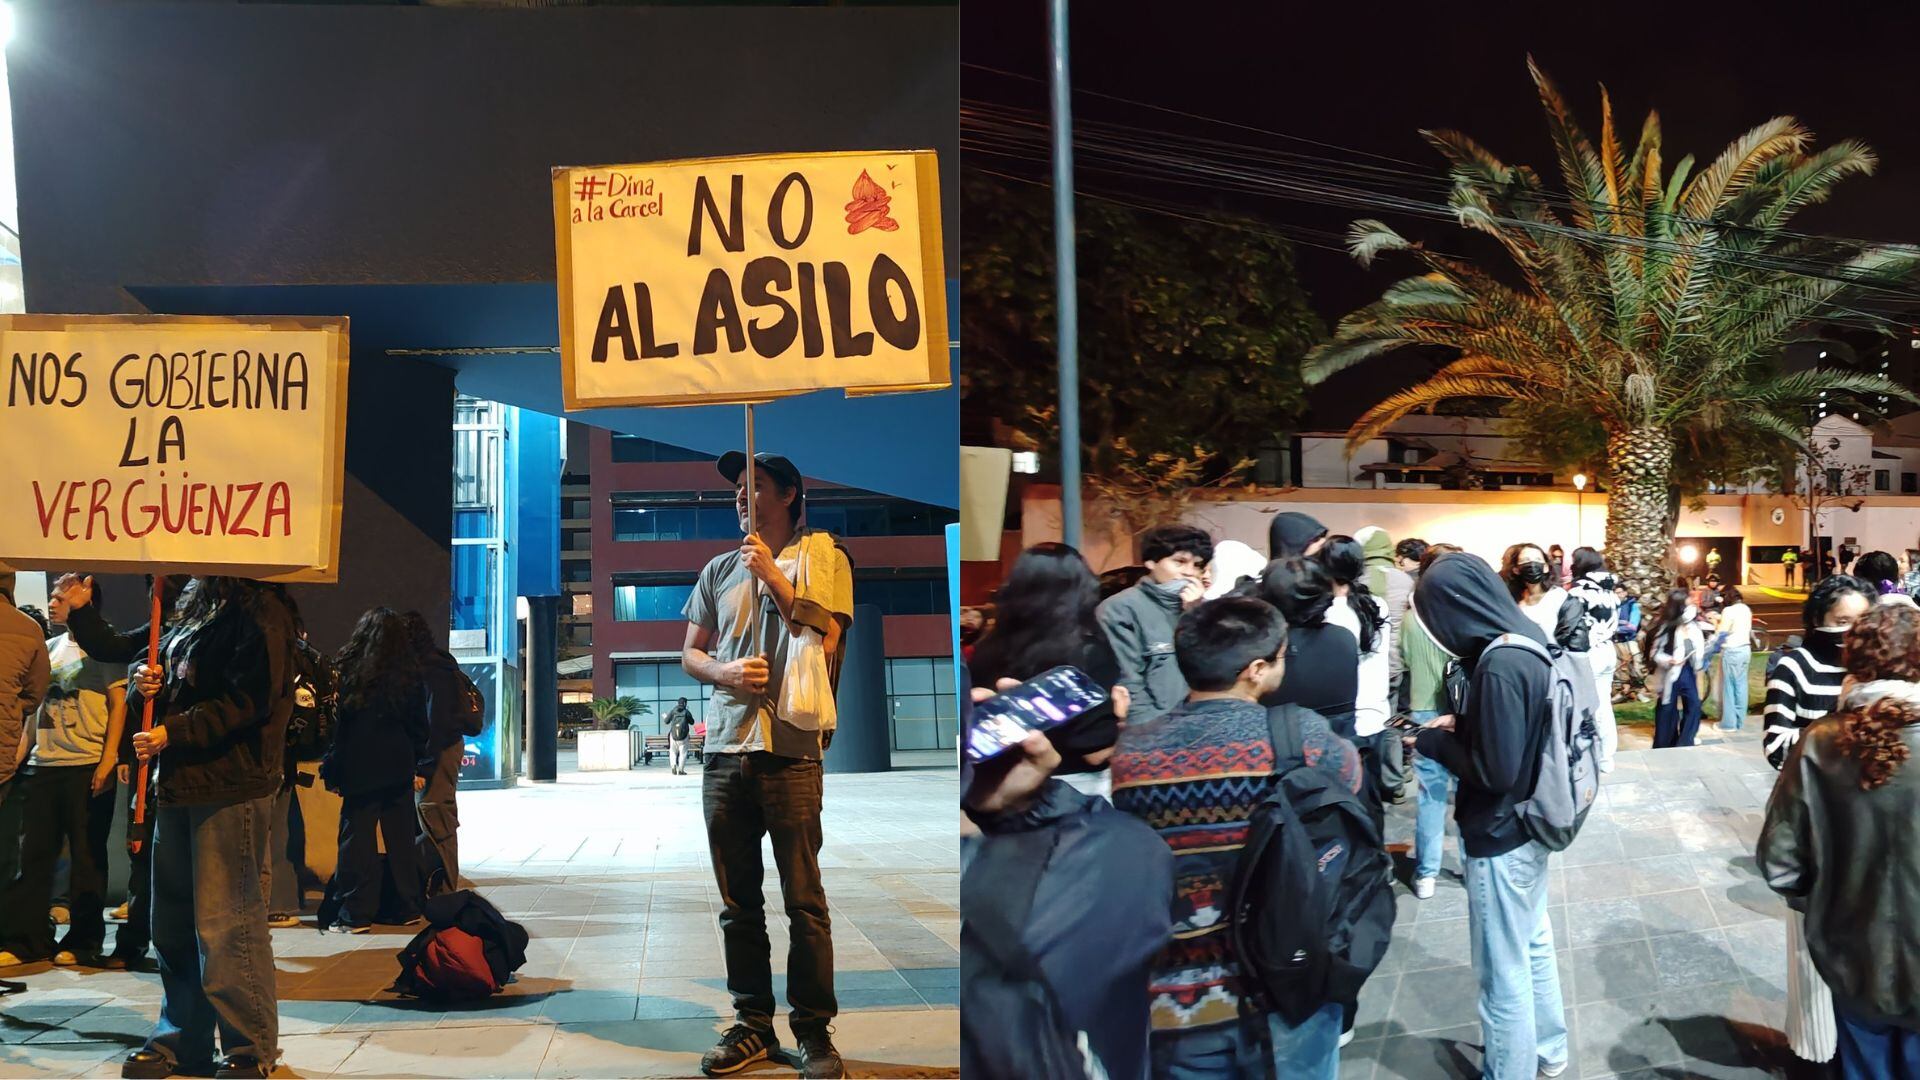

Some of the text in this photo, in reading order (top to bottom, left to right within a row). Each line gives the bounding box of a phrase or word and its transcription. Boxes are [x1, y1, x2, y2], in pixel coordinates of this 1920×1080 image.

[572, 192, 663, 223] a la Carcel
[574, 173, 654, 201] #Dina
[687, 172, 813, 257] NO
[591, 253, 920, 363] AL ASILO
[8, 350, 309, 409] NOS GOBIERNA
[119, 415, 185, 467] LA
[32, 470, 291, 542] VERGÜENZA
